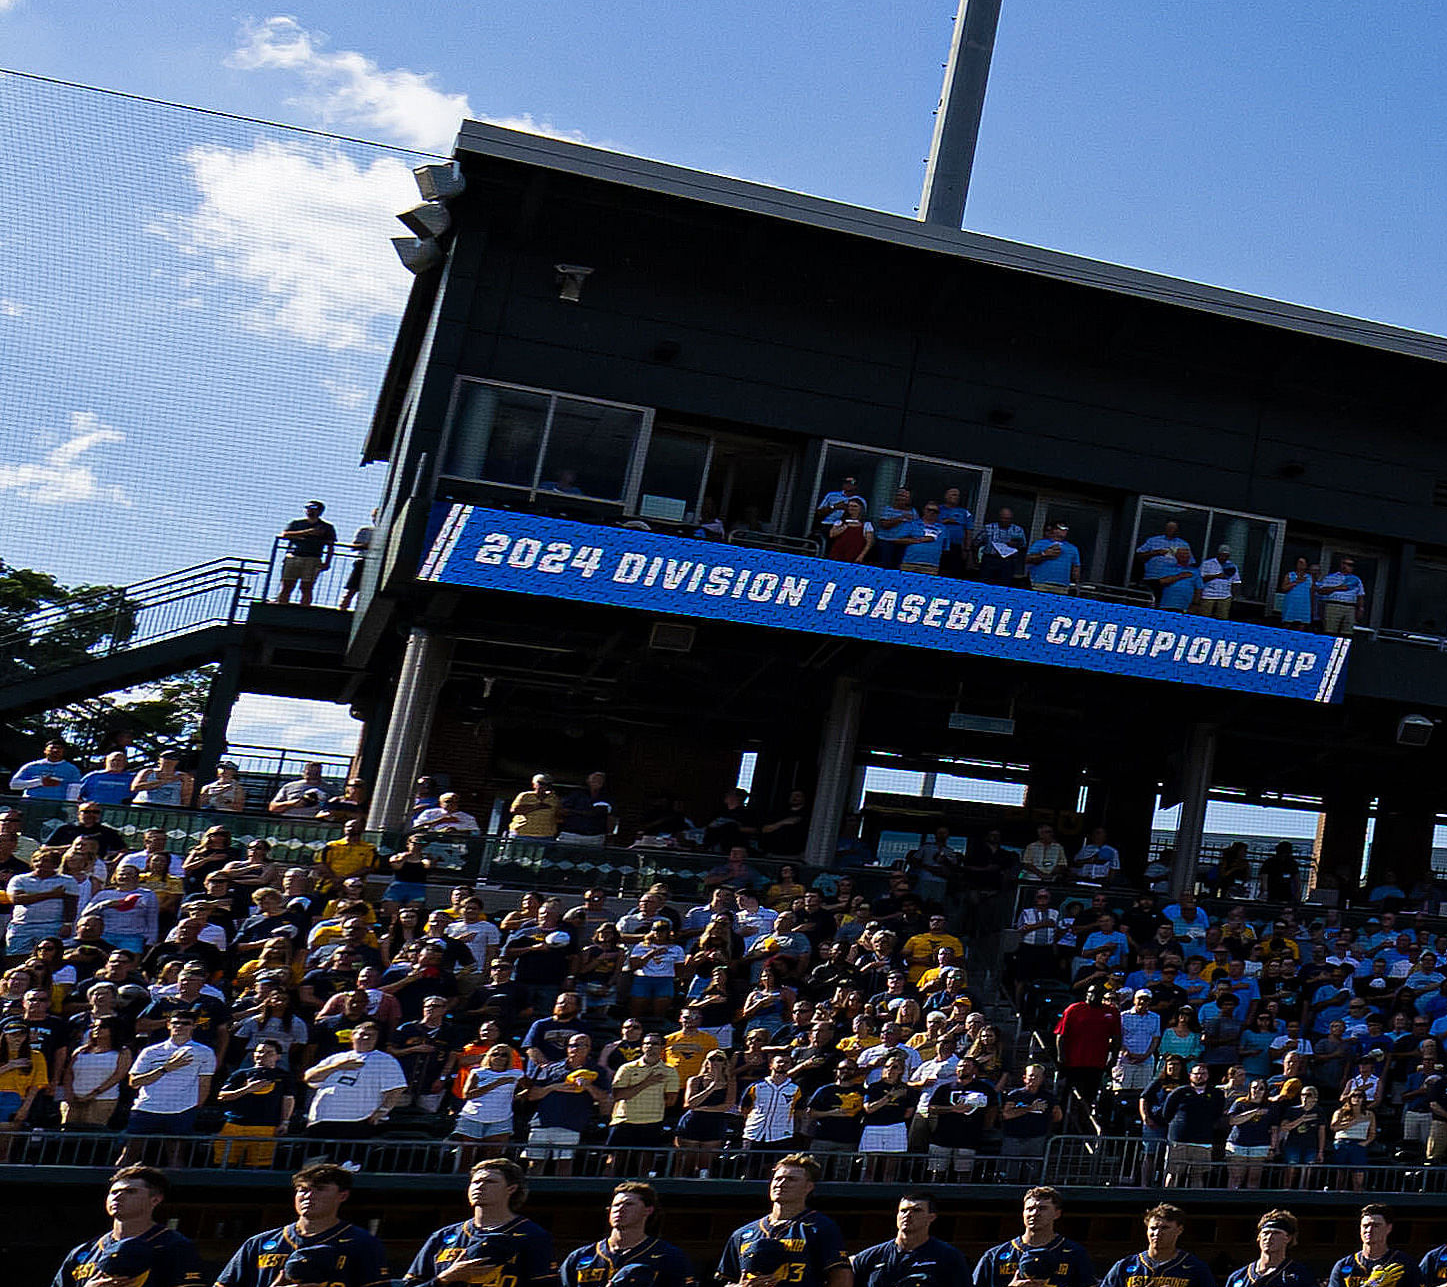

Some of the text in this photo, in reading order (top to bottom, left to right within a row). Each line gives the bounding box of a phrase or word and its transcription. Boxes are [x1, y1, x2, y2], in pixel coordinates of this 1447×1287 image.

[475, 533, 603, 578] 2024
[613, 551, 810, 608] DIVISION
[844, 585, 1033, 641] BASEBALL
[1046, 615, 1318, 678] CHAMPIONSHIP
